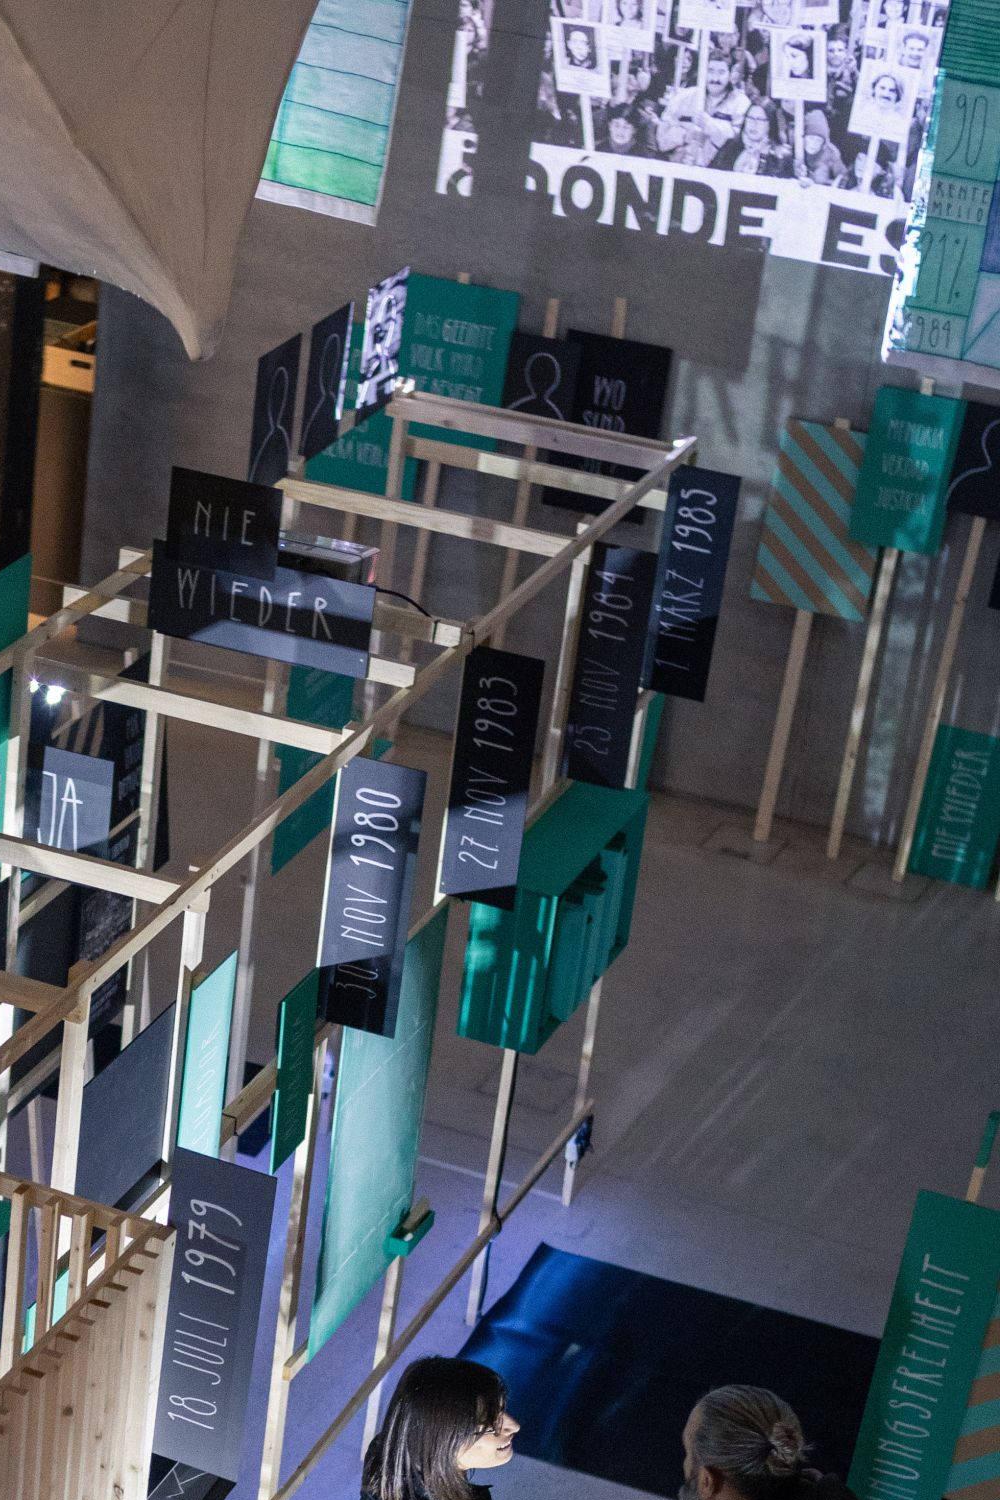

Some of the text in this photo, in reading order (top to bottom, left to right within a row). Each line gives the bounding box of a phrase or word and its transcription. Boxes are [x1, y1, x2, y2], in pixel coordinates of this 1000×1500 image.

[194, 501, 256, 546] NIE
[671, 487, 718, 556] 1985
[177, 567, 333, 640] WIEDER
[655, 568, 705, 643] MÄRZ
[472, 676, 520, 752] 1983
[579, 657, 621, 711] NOV
[36, 770, 84, 851] JA
[349, 786, 403, 871] 1980
[463, 765, 509, 826] NOV
[340, 883, 390, 948] NOV
[181, 1197, 244, 1296] 1979
[171, 1311, 231, 1386] JULI
